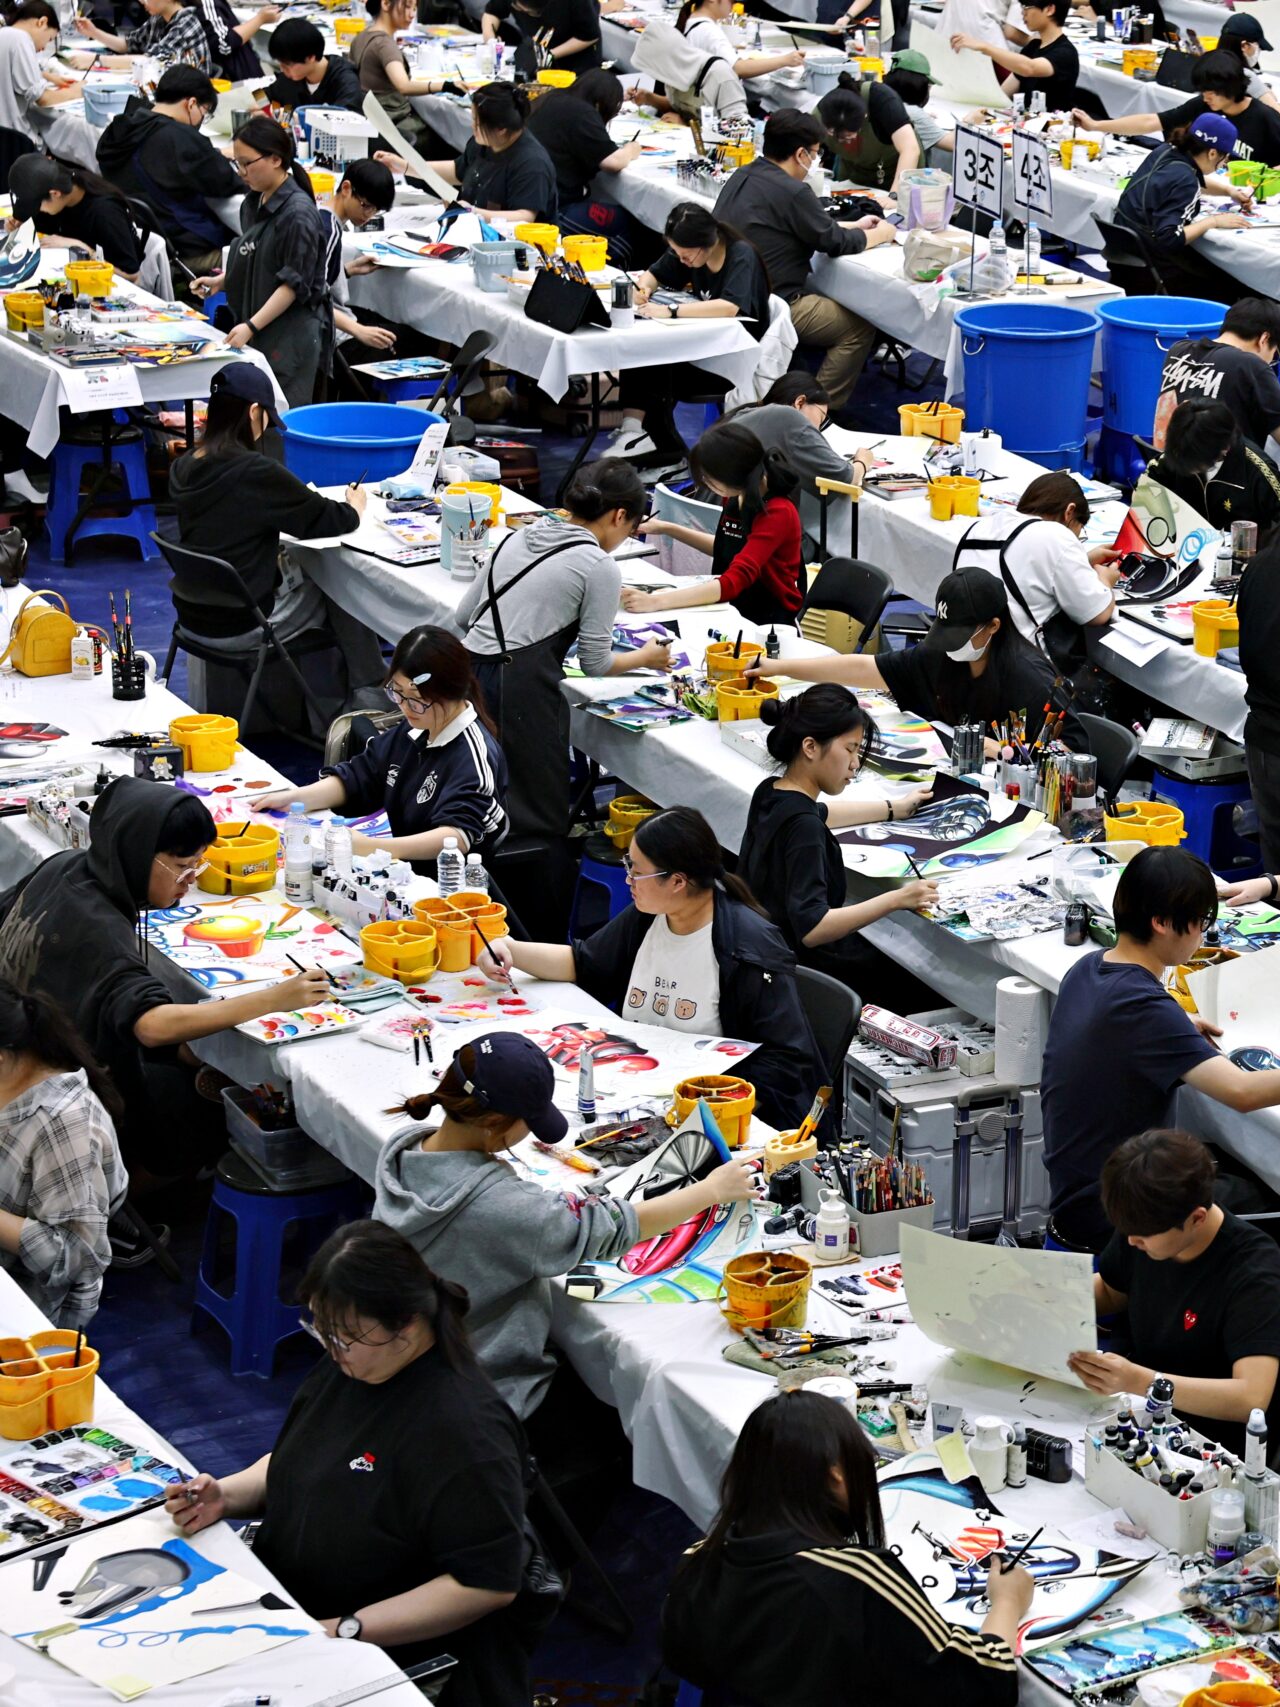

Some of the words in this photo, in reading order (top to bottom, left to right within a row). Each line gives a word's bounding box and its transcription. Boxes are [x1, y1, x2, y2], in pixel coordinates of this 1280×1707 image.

[963, 148, 995, 191] 3조
[1020, 153, 1047, 191] 4조
[655, 976, 677, 990] BEAR
